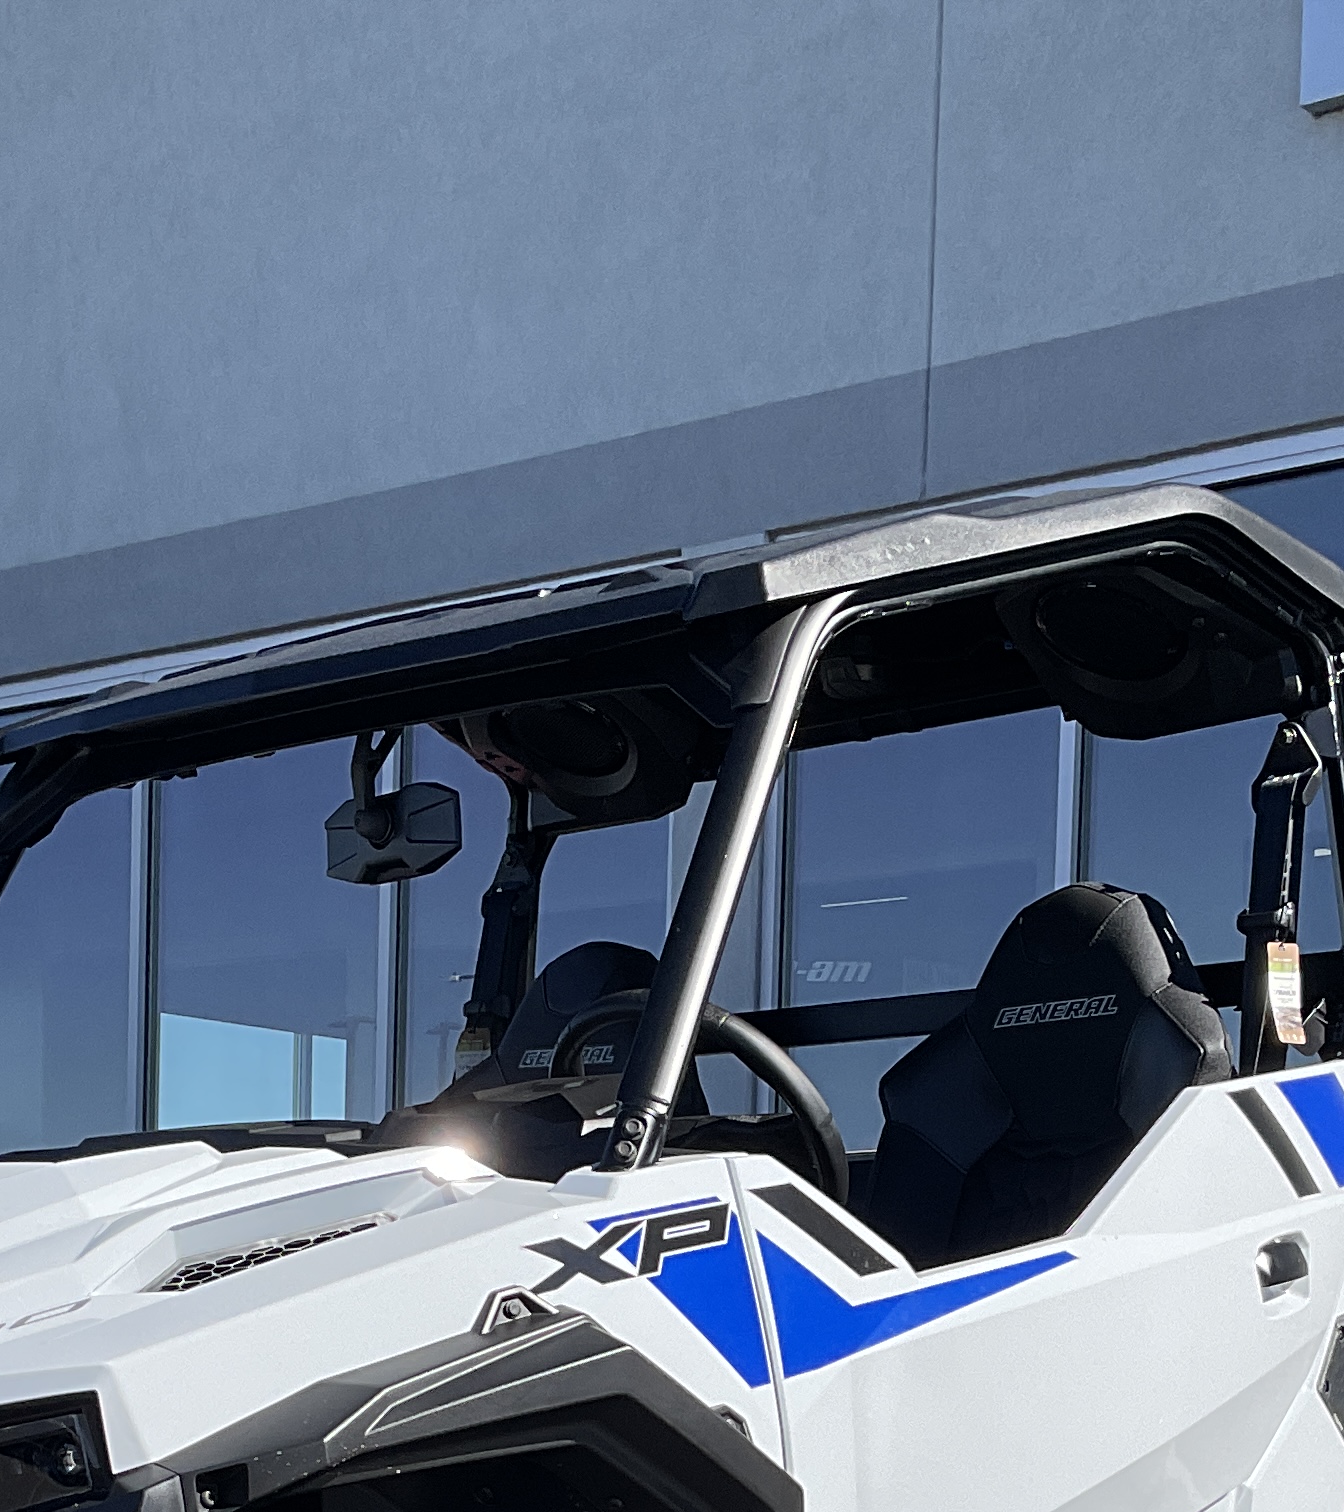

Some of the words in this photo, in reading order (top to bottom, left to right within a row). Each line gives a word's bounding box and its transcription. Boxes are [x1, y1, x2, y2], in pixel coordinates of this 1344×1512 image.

[793, 960, 872, 983] -am
[994, 995, 1118, 1029] GENERAL
[518, 1045, 615, 1069] GEAL
[522, 1202, 731, 1295] XP
